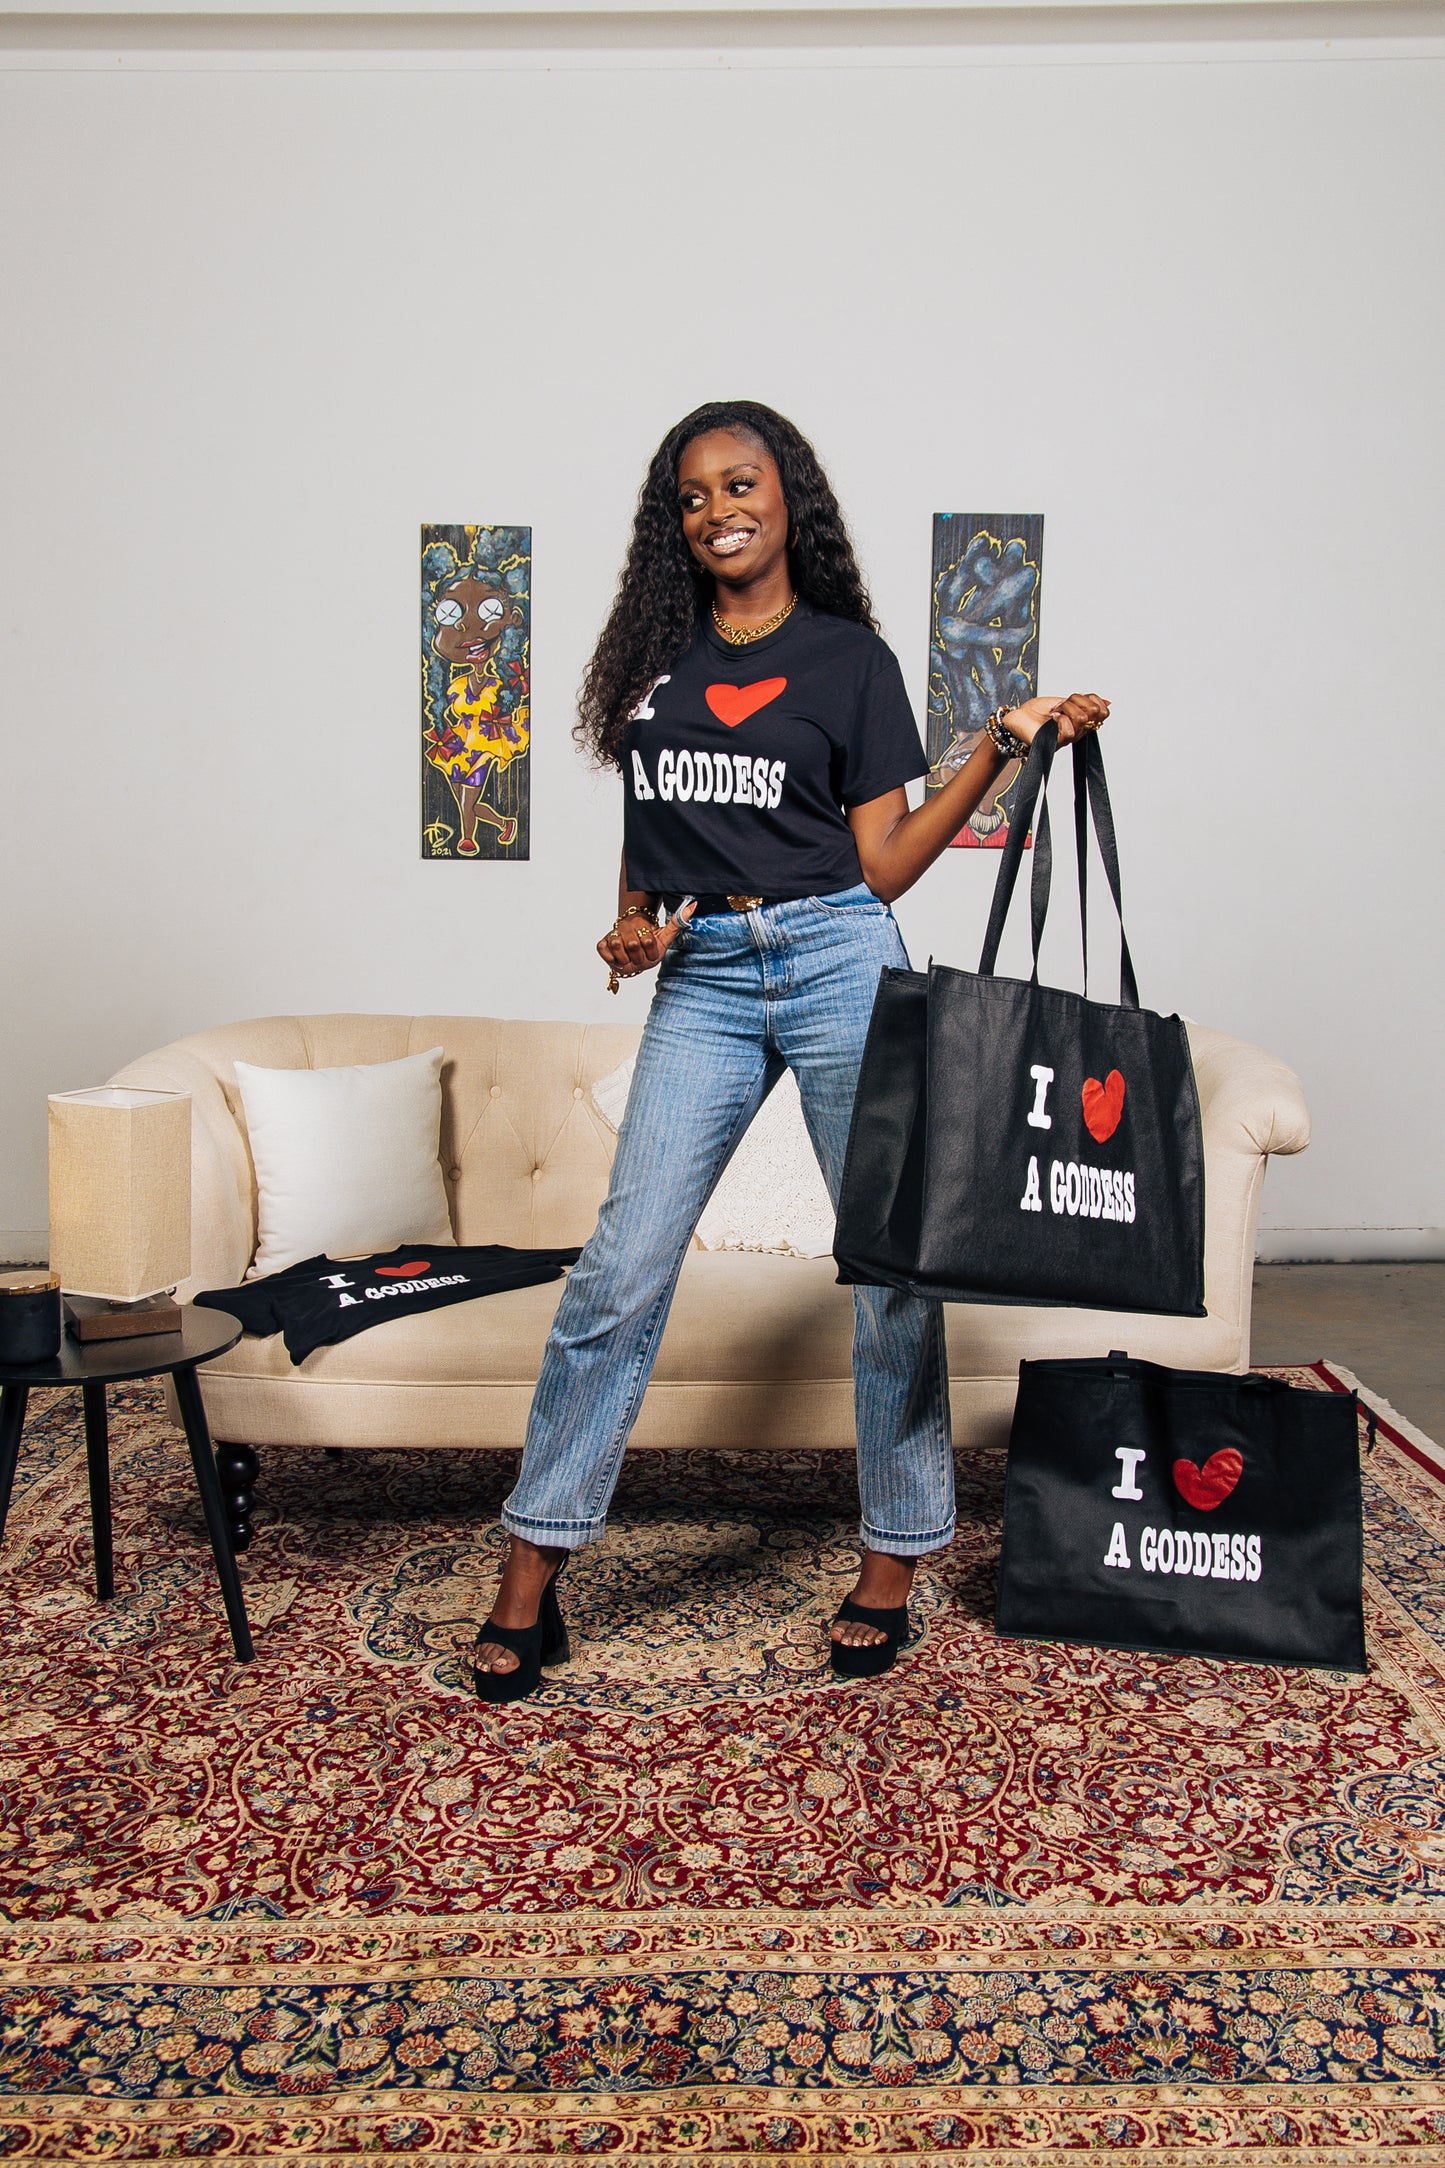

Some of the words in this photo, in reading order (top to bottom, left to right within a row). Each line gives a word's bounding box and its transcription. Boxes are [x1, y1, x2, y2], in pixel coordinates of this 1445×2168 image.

[631, 749, 655, 801] A
[657, 749, 786, 809] GODDESS
[1027, 1064, 1055, 1130] I
[1020, 1155, 1042, 1212] A
[1050, 1159, 1136, 1223] GODDESS
[319, 1273, 355, 1289] I
[338, 1292, 364, 1308] A
[365, 1274, 471, 1300] GODDESS
[1111, 1446, 1147, 1501] I
[1103, 1522, 1131, 1569] A
[1140, 1526, 1262, 1582] GODDESS
